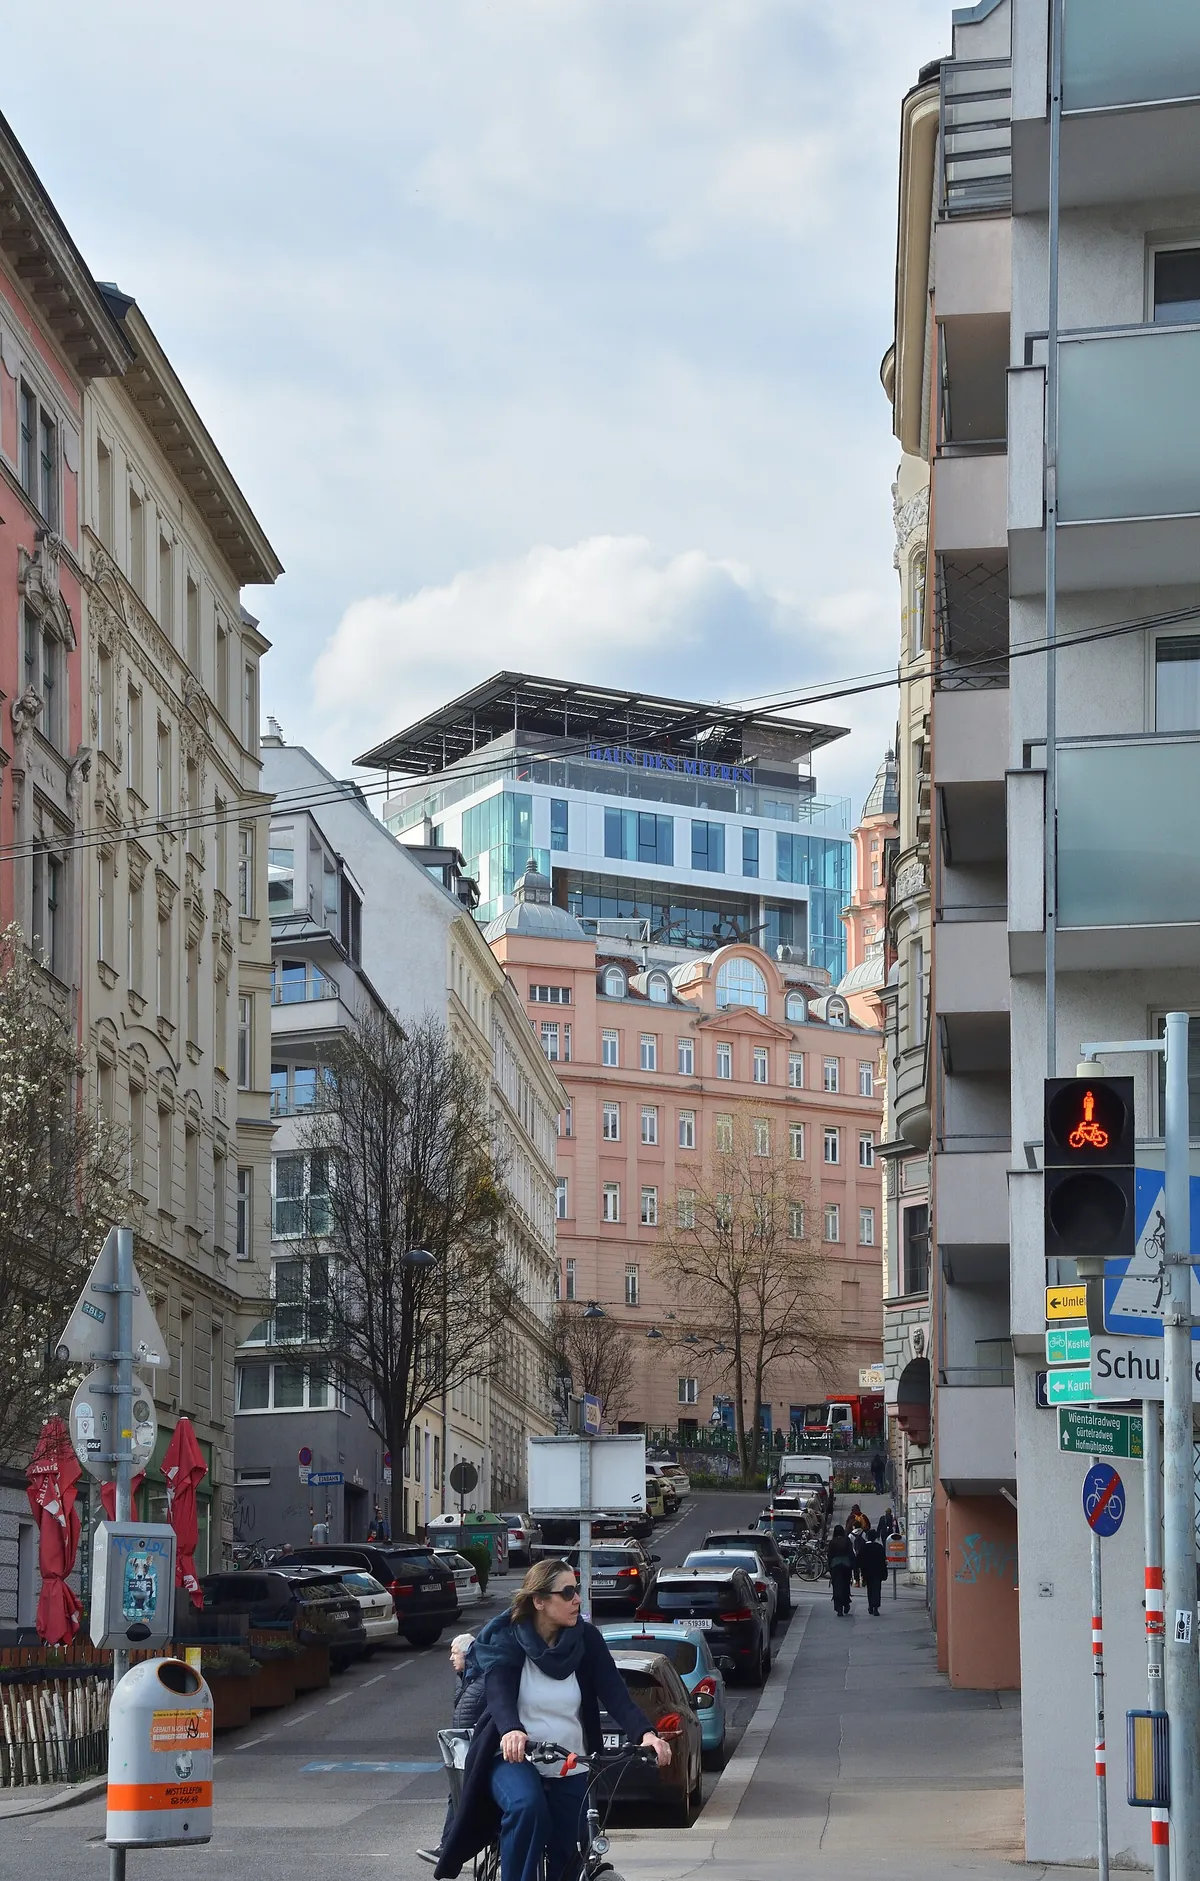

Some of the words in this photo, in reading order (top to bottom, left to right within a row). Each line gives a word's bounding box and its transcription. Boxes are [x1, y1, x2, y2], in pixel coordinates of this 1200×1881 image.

[589, 744, 635, 765] HAUS
[643, 752, 677, 771] DES
[683, 759, 752, 783] MEERES
[1097, 1348, 1200, 1383] Schu
[1068, 1411, 1120, 1431] Wientalradweg
[1076, 1426, 1113, 1442] Gürtelradweg
[1075, 1439, 1114, 1453] Hofmühlgasse
